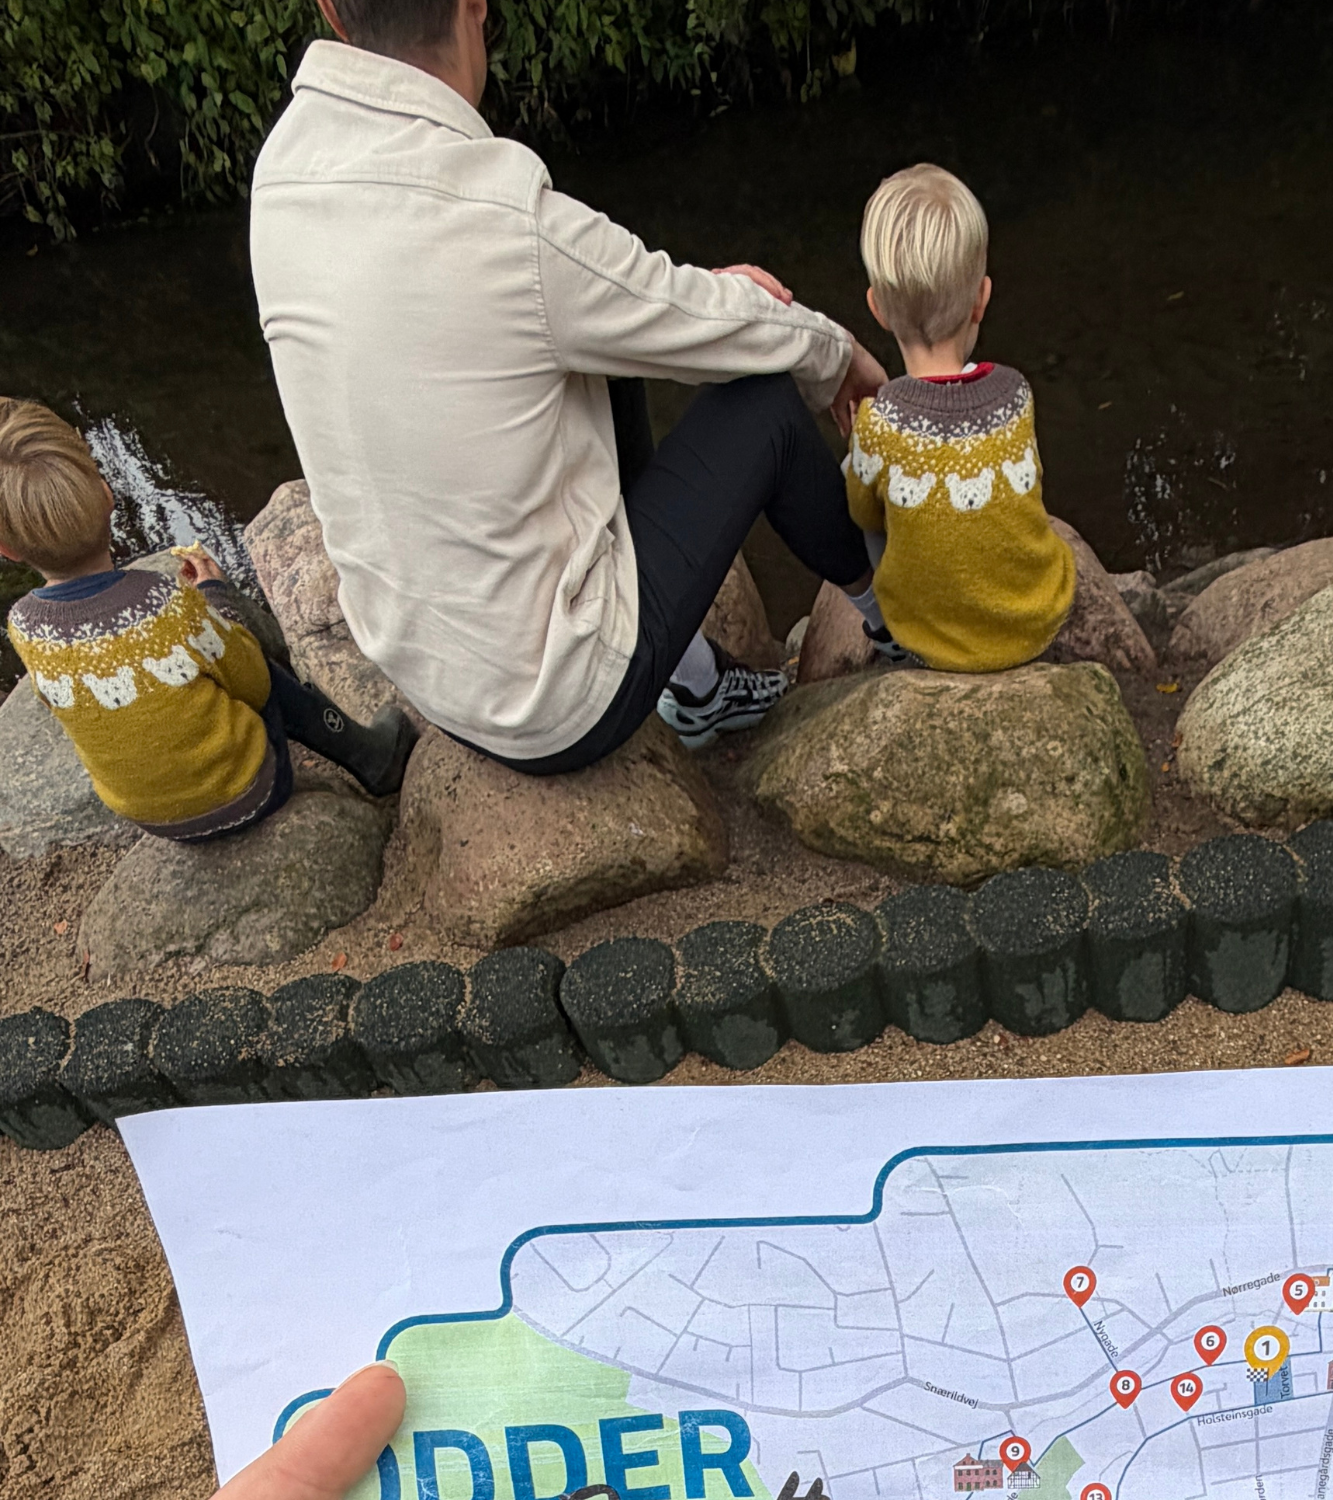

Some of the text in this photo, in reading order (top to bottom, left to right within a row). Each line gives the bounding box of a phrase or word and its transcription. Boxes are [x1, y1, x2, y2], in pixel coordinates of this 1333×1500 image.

[1076, 1276, 1085, 1289] 7
[1222, 1273, 1281, 1298] Nørregade
[1294, 1284, 1304, 1296] 5
[1094, 1319, 1119, 1359] Nygade
[1205, 1335, 1215, 1347] 6
[1260, 1340, 1271, 1356] 1
[1121, 1379, 1130, 1391] 8
[1179, 1382, 1194, 1393] 14
[1281, 1365, 1291, 1400] Torvet
[923, 1381, 979, 1409] Snærildvej
[1197, 1404, 1274, 1427] Holsteinsgade
[1010, 1445, 1020, 1457] 9
